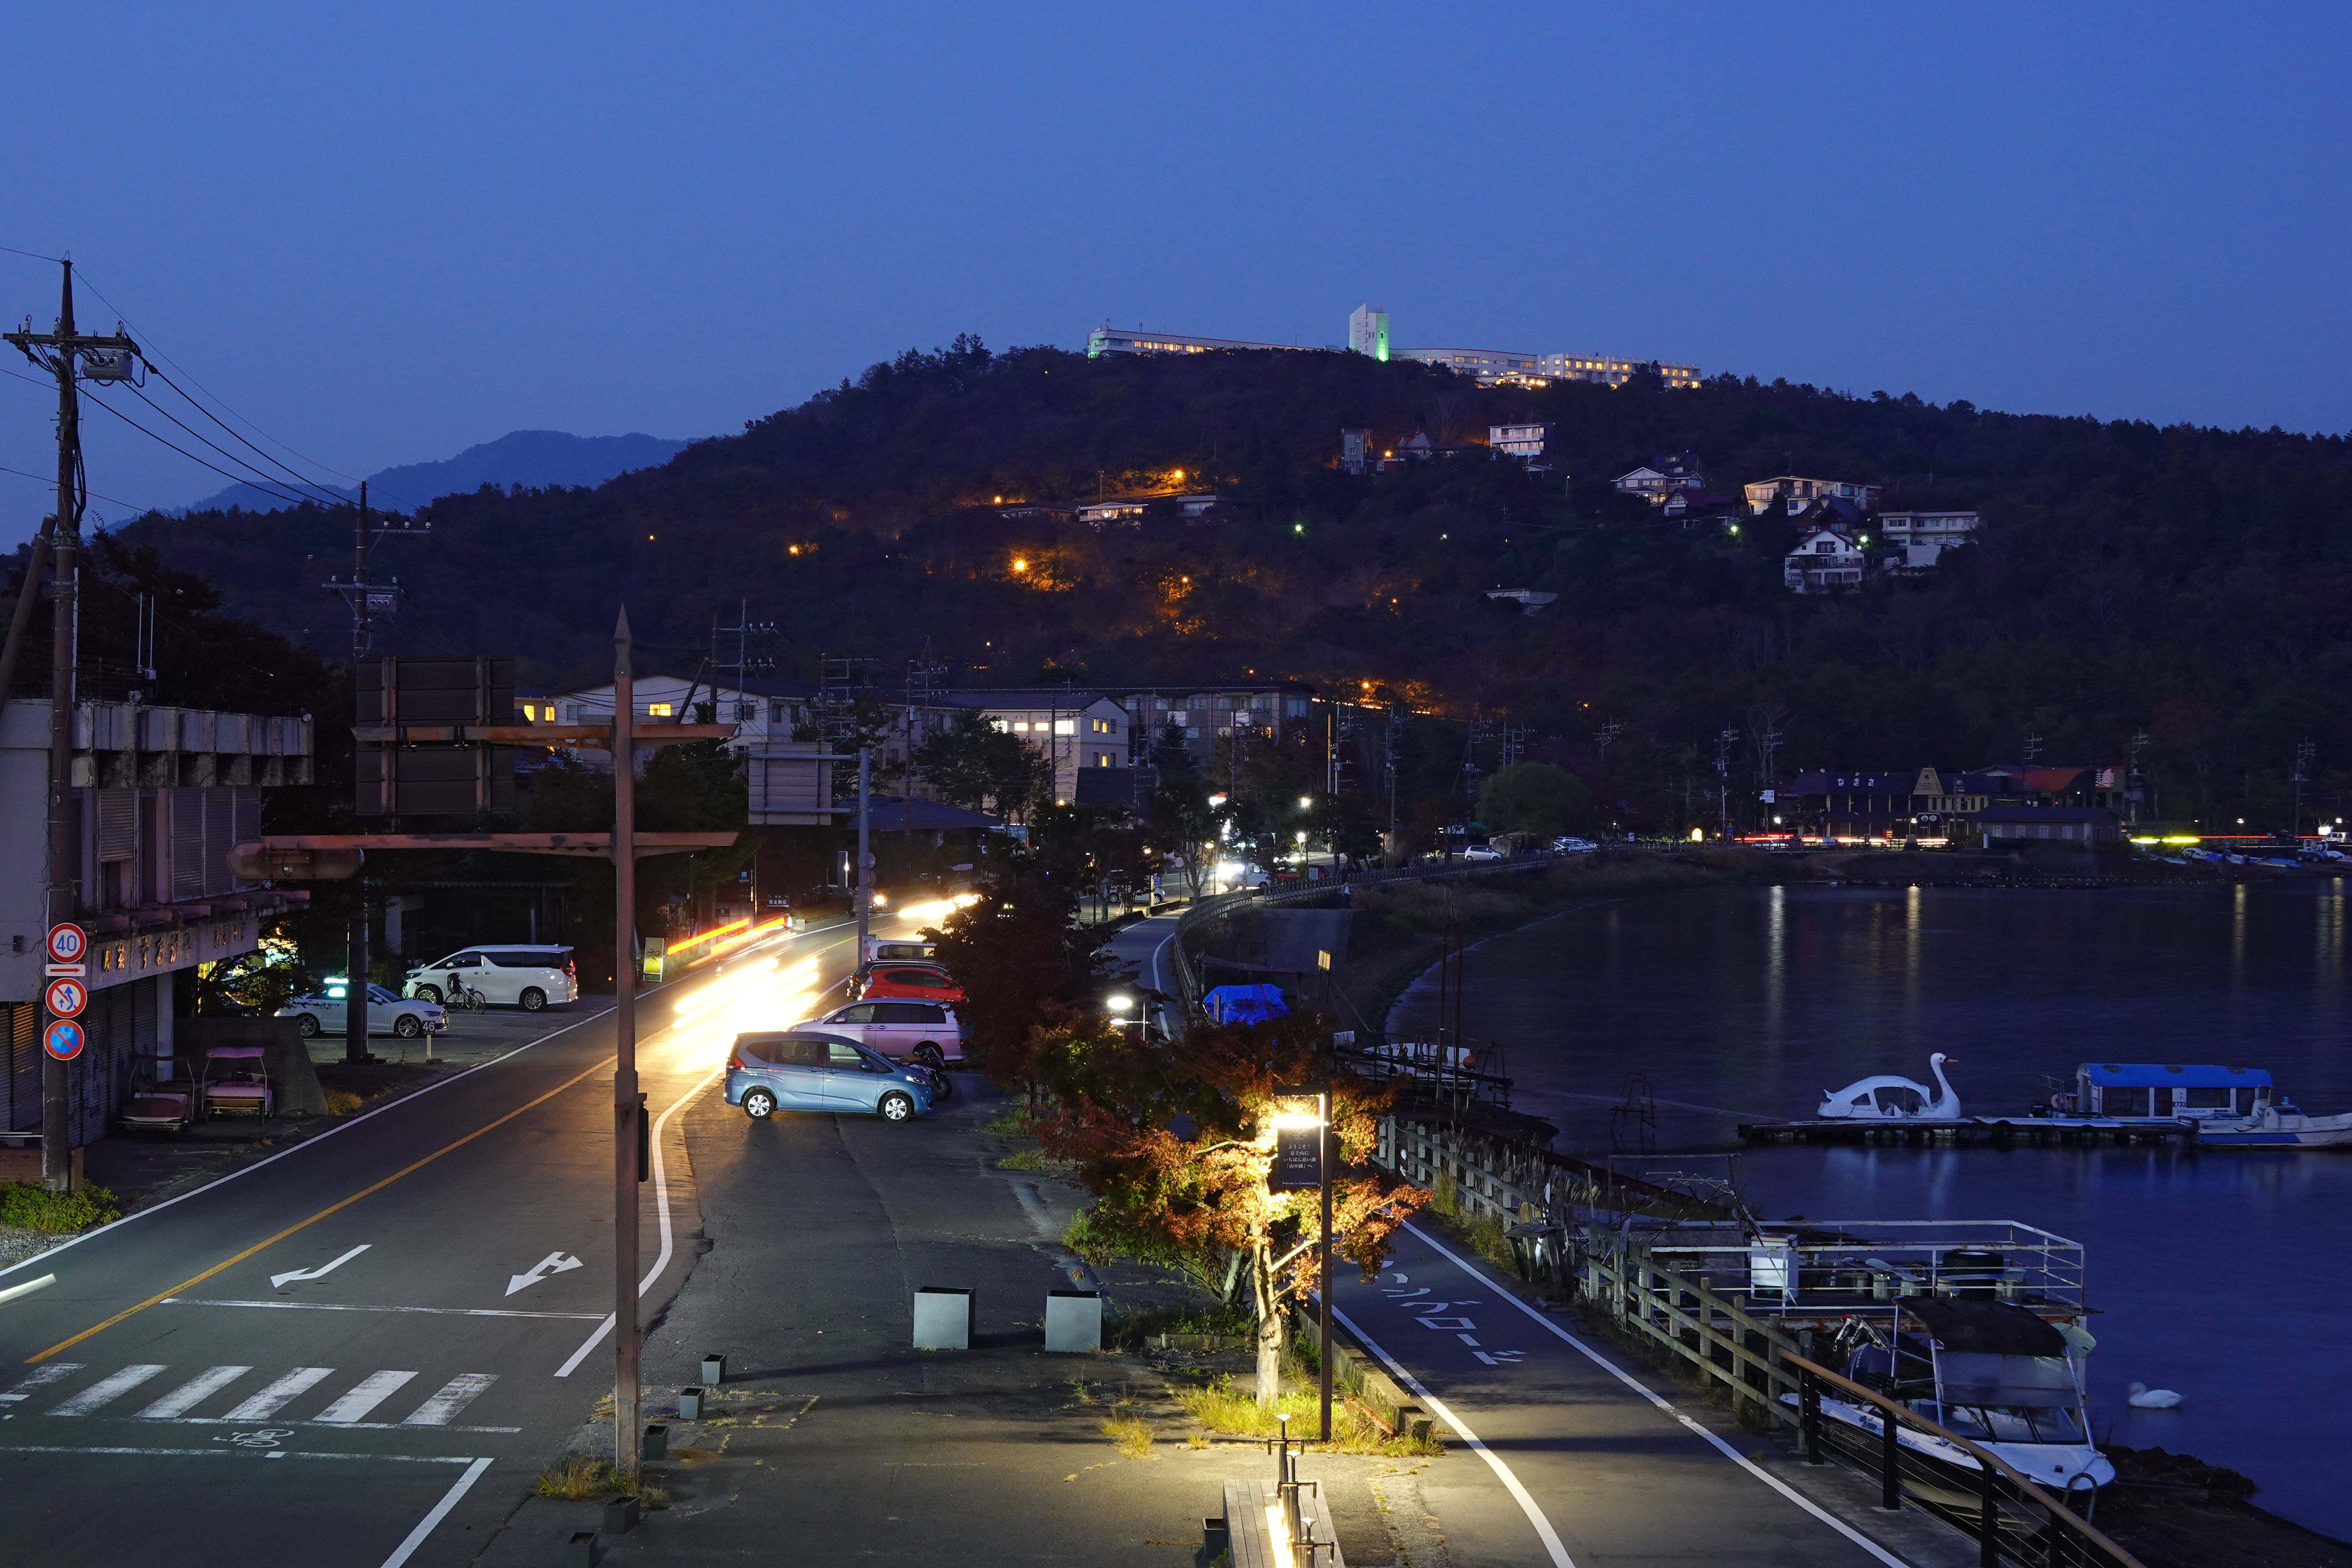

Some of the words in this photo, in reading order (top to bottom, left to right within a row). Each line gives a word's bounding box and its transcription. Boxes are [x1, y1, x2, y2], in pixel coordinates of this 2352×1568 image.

[1837, 778, 1874, 787] なぎさ
[56, 934, 77, 951] 40
[423, 1021, 435, 1031] 46
